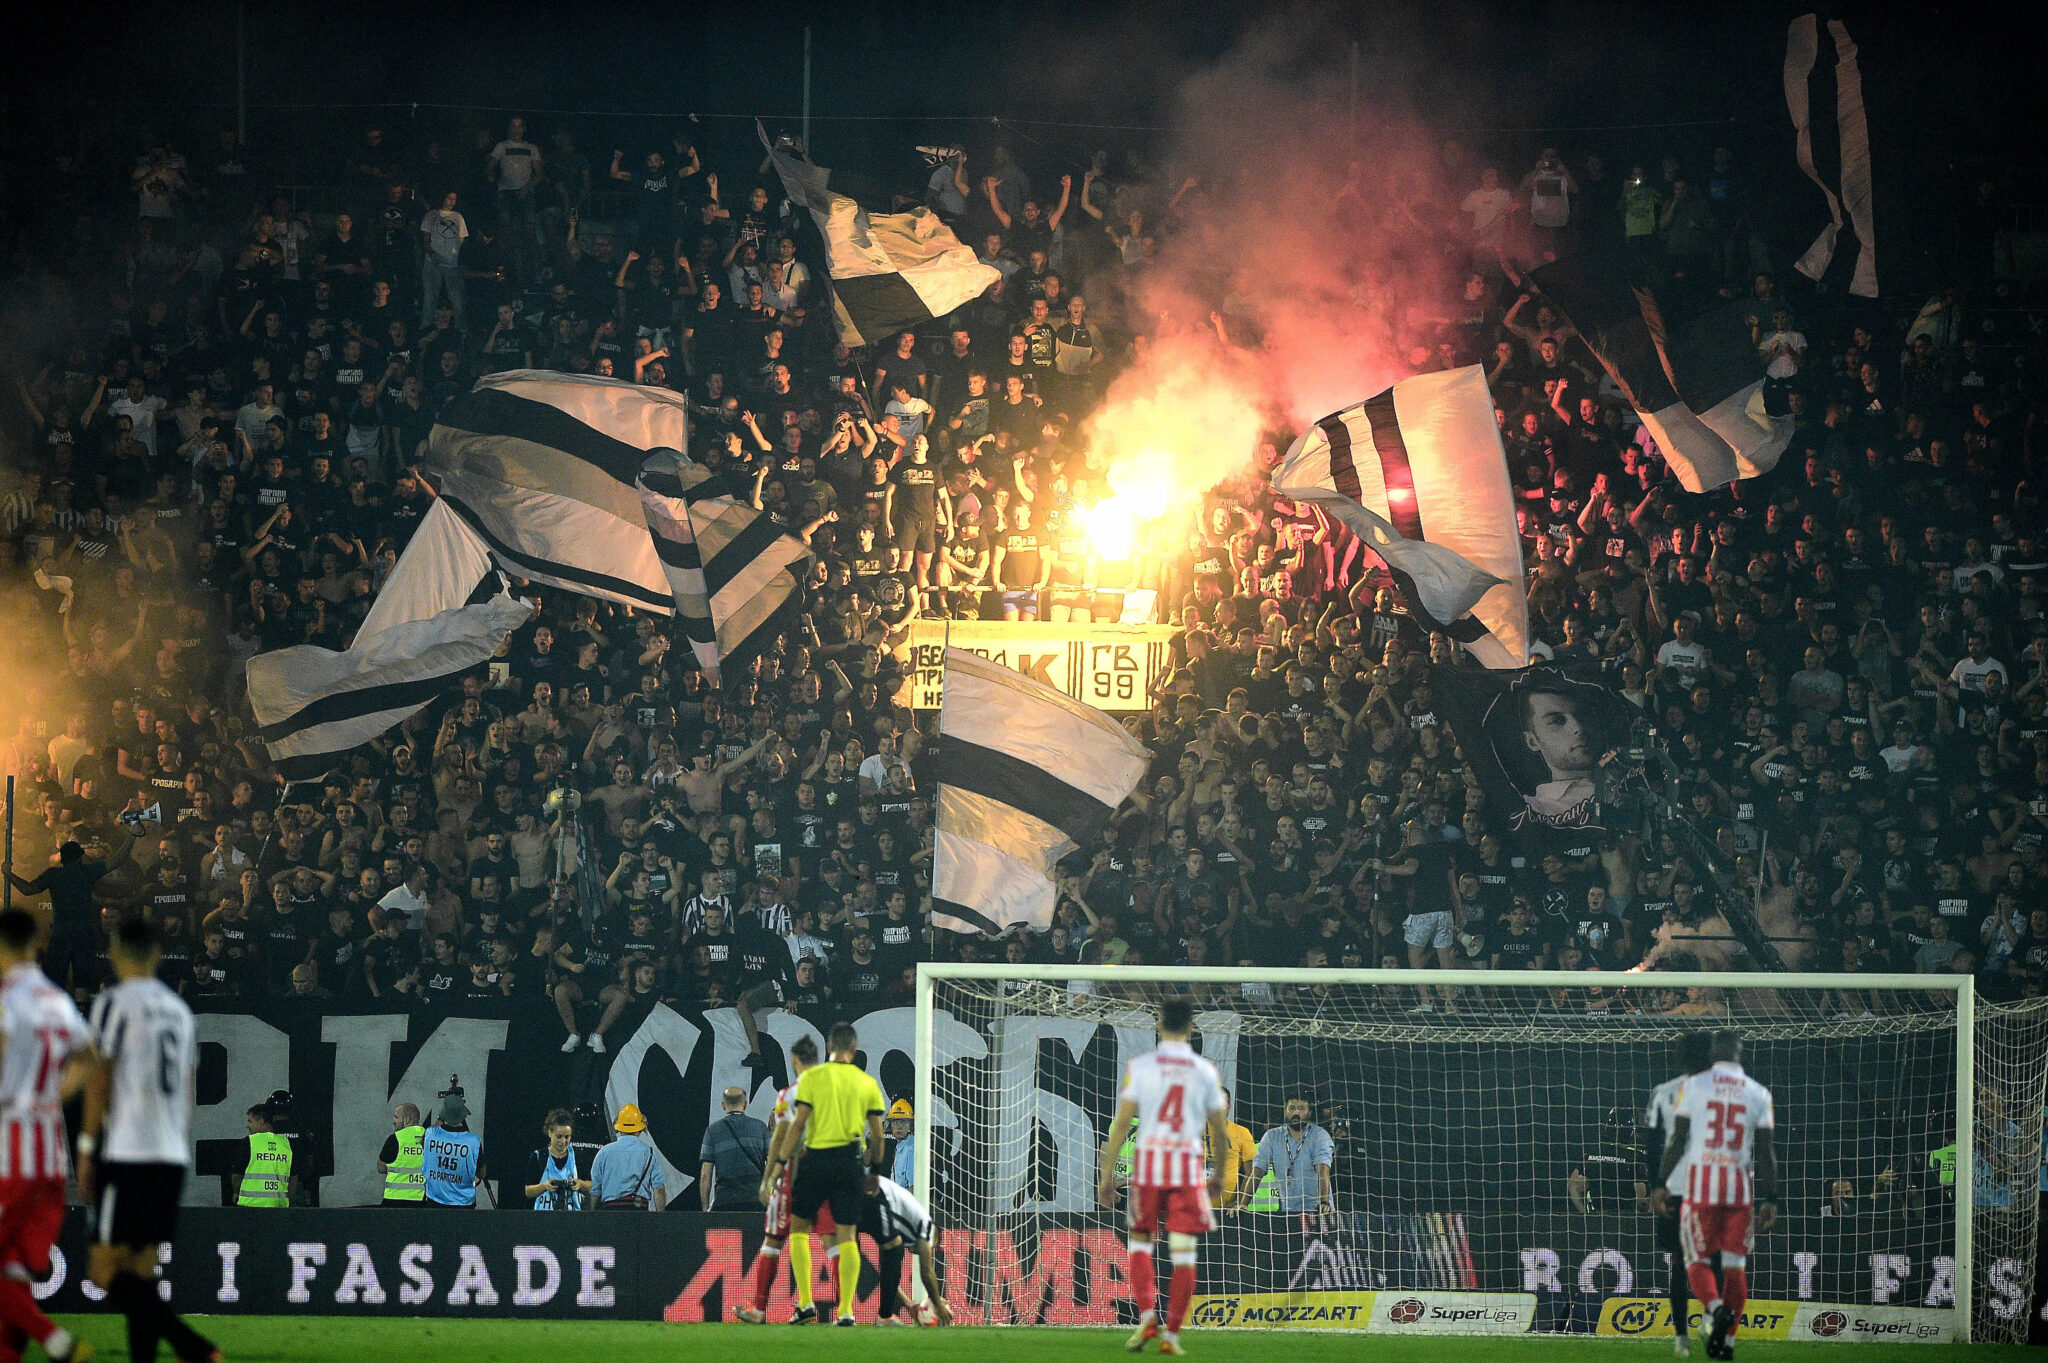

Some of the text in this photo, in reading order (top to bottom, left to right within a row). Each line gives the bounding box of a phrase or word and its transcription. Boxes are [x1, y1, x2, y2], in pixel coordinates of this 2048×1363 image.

[1095, 672, 1133, 699] 99
[152, 778, 183, 789] ГРОБАРИ
[38, 902, 53, 910] ГРО
[154, 894, 186, 904] ГРОБАРИ
[159, 1029, 182, 1097] 6
[1157, 1084, 1185, 1133] 4
[1705, 1100, 1746, 1150] 35
[256, 1152, 288, 1163] REDAR
[429, 1140, 469, 1158] PHOTO
[437, 1155, 458, 1171] 145
[264, 1182, 279, 1191] 035
[408, 1174, 424, 1184] 045
[217, 1242, 240, 1303] I
[286, 1241, 616, 1306] FASADE
[1242, 1305, 1363, 1323] MOZZART
[1429, 1306, 1517, 1323] SuperLiga
[1851, 1317, 1941, 1340] SuperLiga
